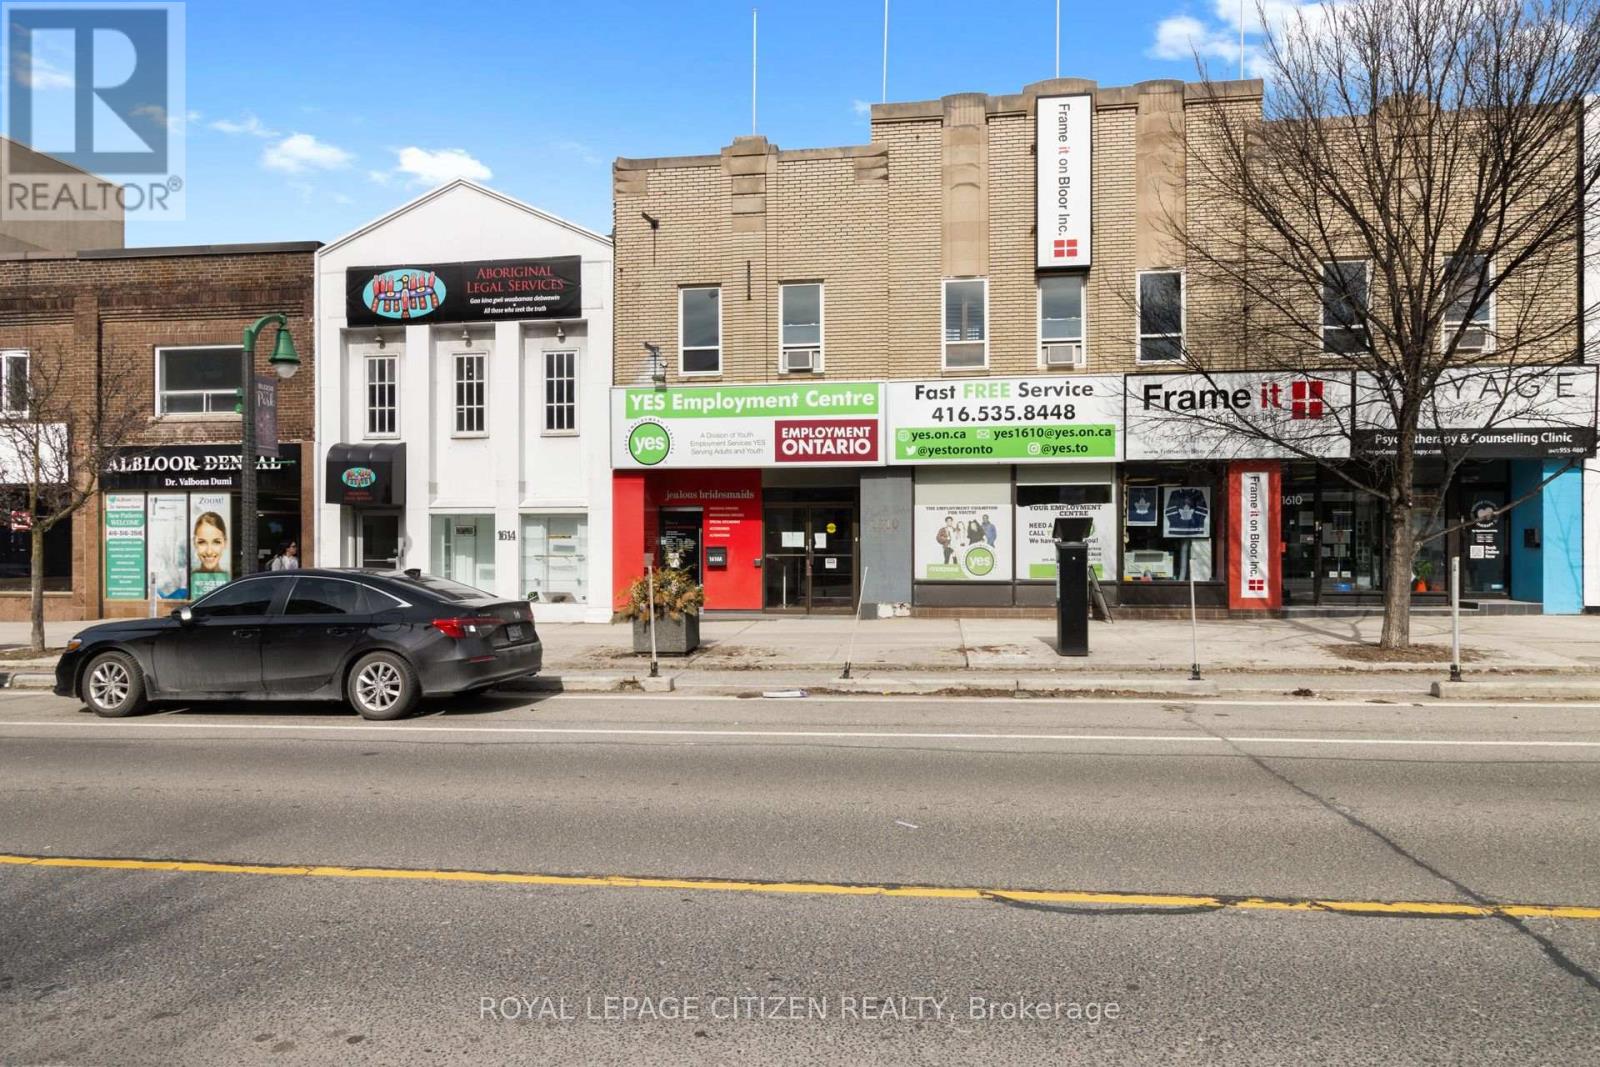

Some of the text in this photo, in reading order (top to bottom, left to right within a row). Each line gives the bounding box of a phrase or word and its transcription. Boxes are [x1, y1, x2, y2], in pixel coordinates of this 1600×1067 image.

[1058, 103, 1070, 236] Frame it on Bloor Inc.
[476, 265, 554, 280] ABORIGINAL
[467, 278, 564, 294] LEGAL SERVICES
[915, 380, 1094, 400] Fast FREE Service
[1143, 382, 1283, 411] Frame it
[630, 390, 875, 413] YES Employment Centre
[931, 404, 1076, 423] 416.535.8448
[782, 426, 871, 438] EMPLOYMENT
[911, 429, 967, 441] yes.on.ca
[993, 427, 1112, 440] yes1610@yes.on.ca
[1375, 433, 1458, 446] Psyctherapy
[1460, 433, 1469, 444] &
[1541, 432, 1573, 443] Clinic
[634, 436, 665, 455] yes
[781, 438, 871, 455] ONTARIO
[917, 445, 994, 456] @yestoronto
[1041, 443, 1088, 455] @yes.to
[203, 455, 282, 471] DENAL
[165, 476, 232, 486] Dr. Valbona Dumi
[665, 489, 755, 501] jealous bridesmaids
[1250, 475, 1260, 509] Frame
[1281, 495, 1303, 505] 1610
[1250, 519, 1258, 532] on
[497, 530, 516, 541] 1614
[1250, 533, 1260, 559] Bloor
[969, 556, 991, 569] yes
[1250, 560, 1260, 577] Inc.
